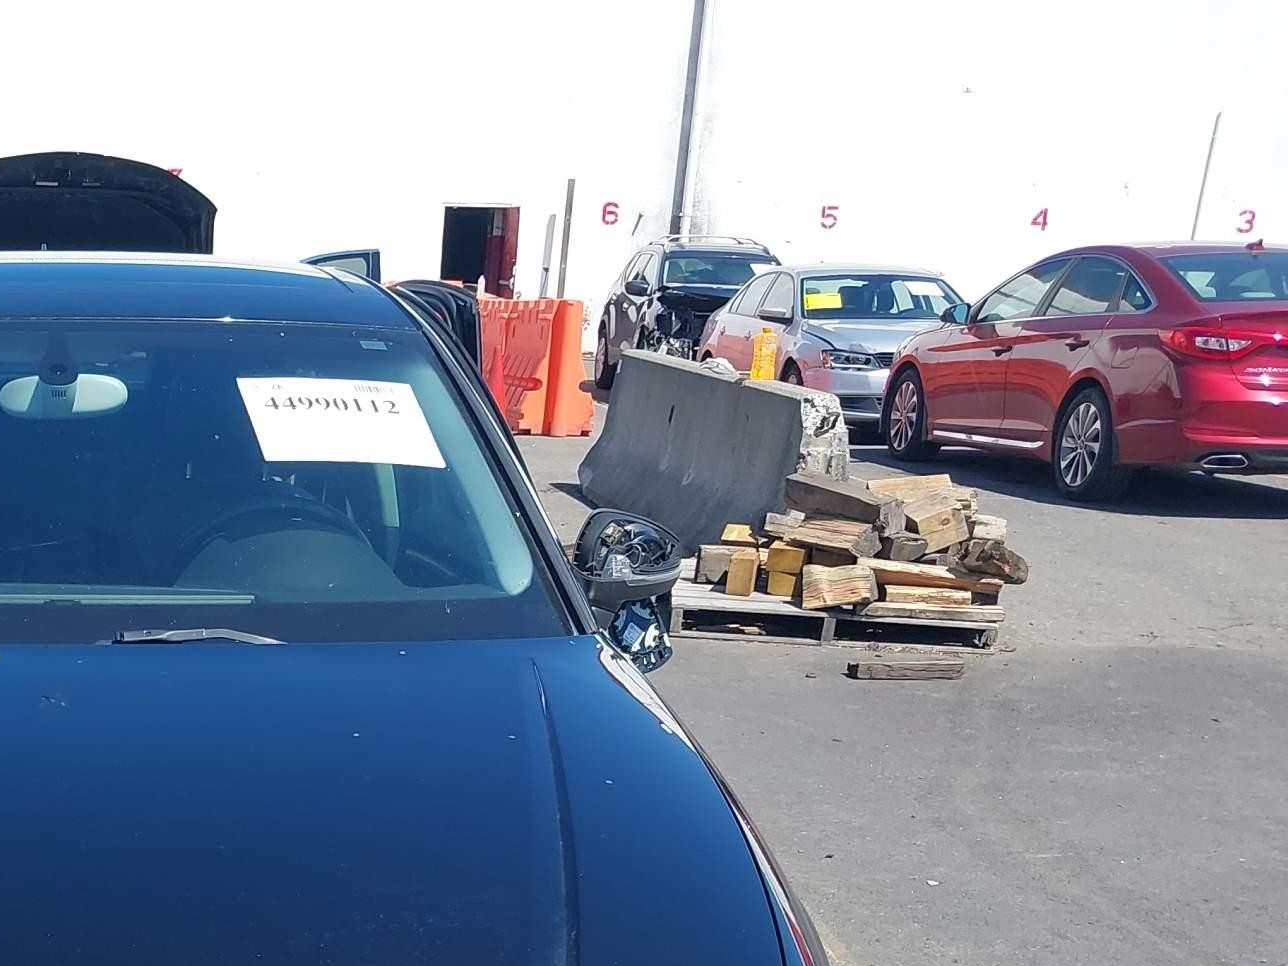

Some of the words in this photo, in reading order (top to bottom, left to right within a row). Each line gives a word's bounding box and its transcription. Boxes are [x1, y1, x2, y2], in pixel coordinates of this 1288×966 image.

[602, 202, 619, 225] 6
[820, 205, 839, 229] 5
[1030, 208, 1048, 231] 4
[1236, 210, 1255, 234] 3
[264, 396, 400, 414] 44990112
